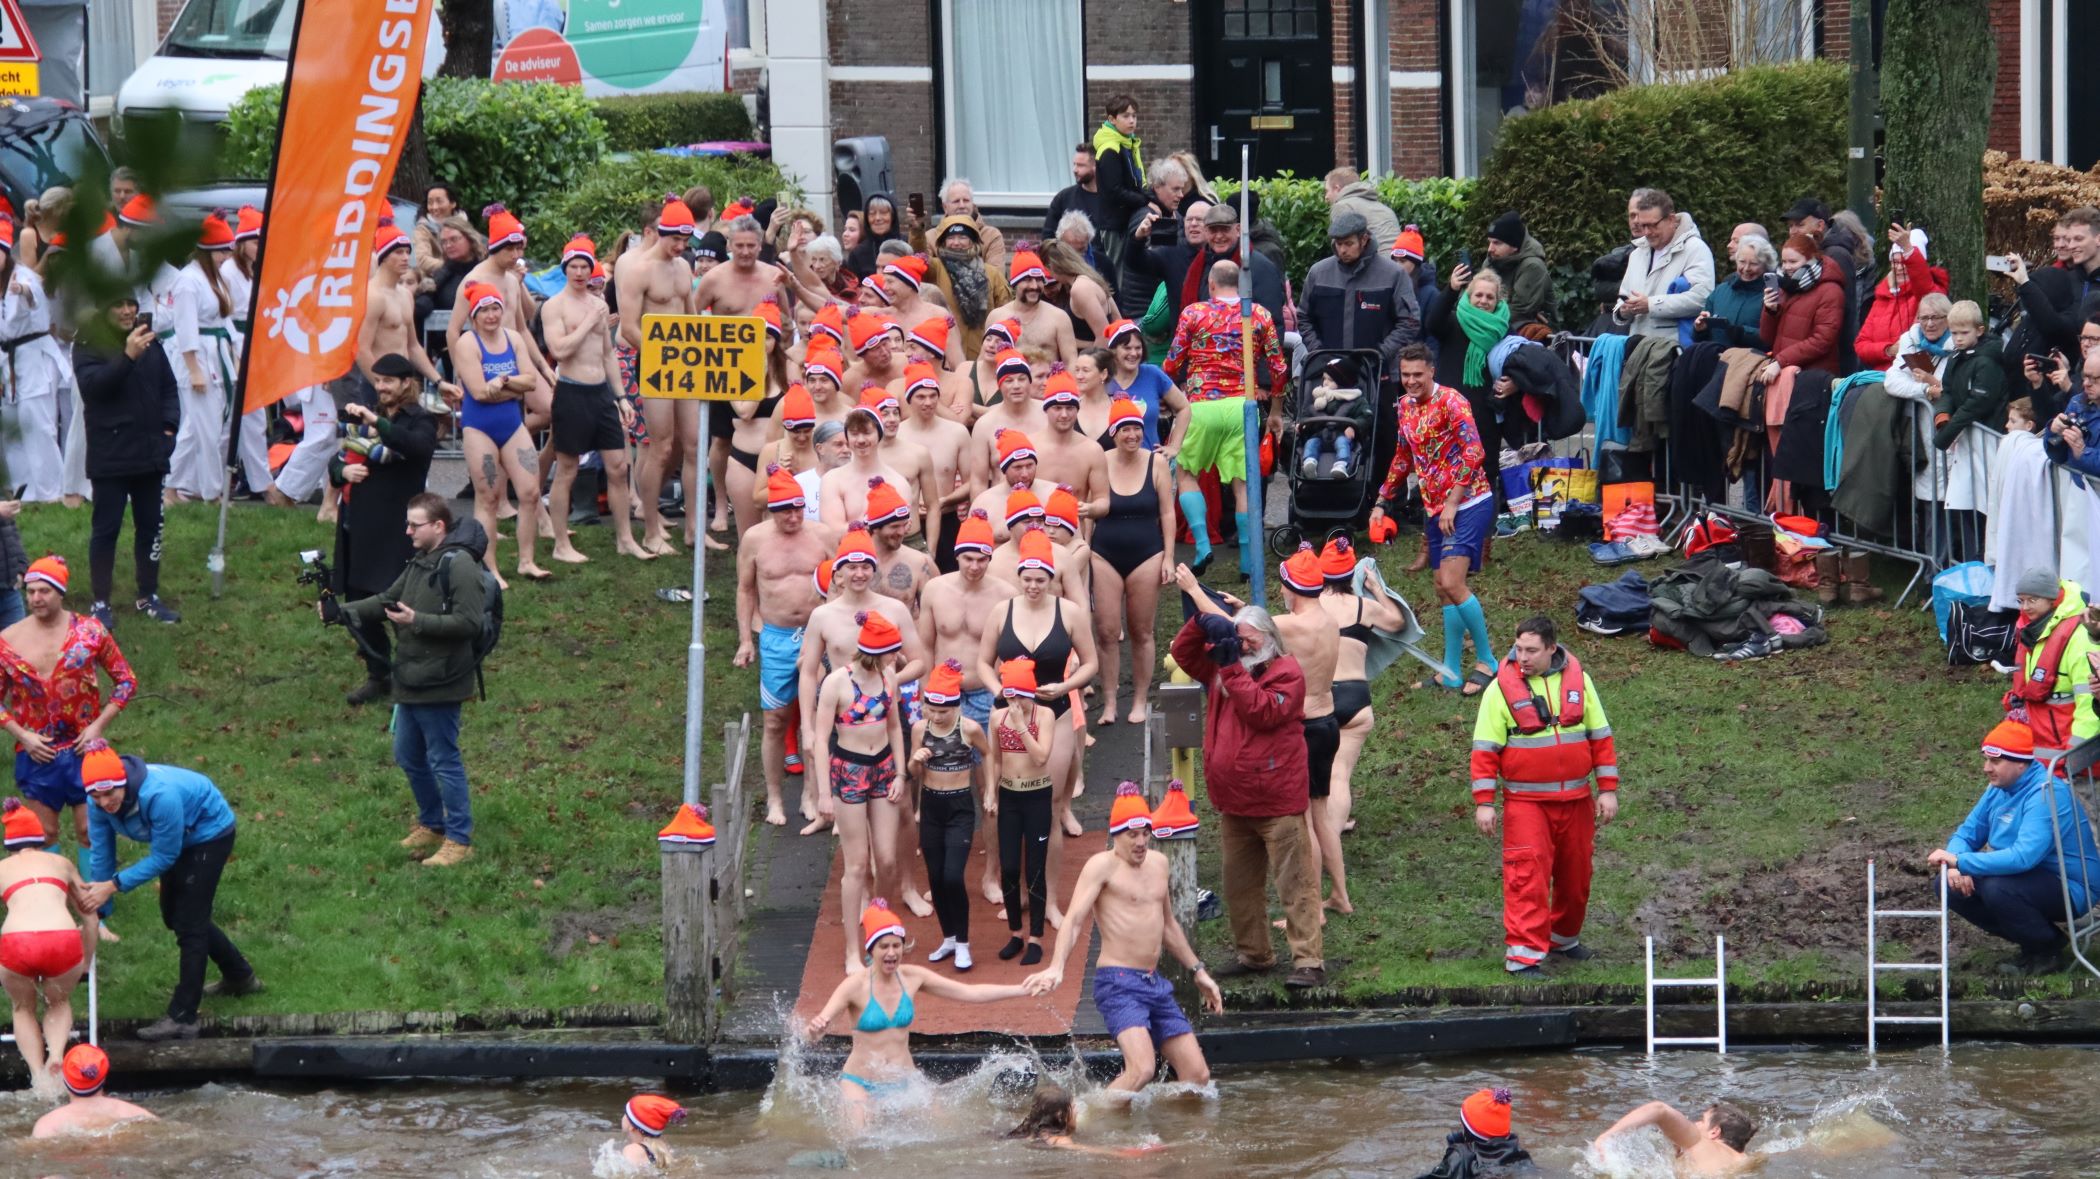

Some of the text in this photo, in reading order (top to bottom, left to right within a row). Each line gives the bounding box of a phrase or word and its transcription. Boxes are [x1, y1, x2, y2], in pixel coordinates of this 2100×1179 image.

[584, 12, 684, 32] Samen zorgen we ervoor
[505, 56, 561, 73] De adviseur
[648, 322, 756, 343] AANLEG
[661, 346, 744, 367] PONT
[664, 369, 737, 394] 14 M.
[1020, 779, 1042, 789] NIKE
